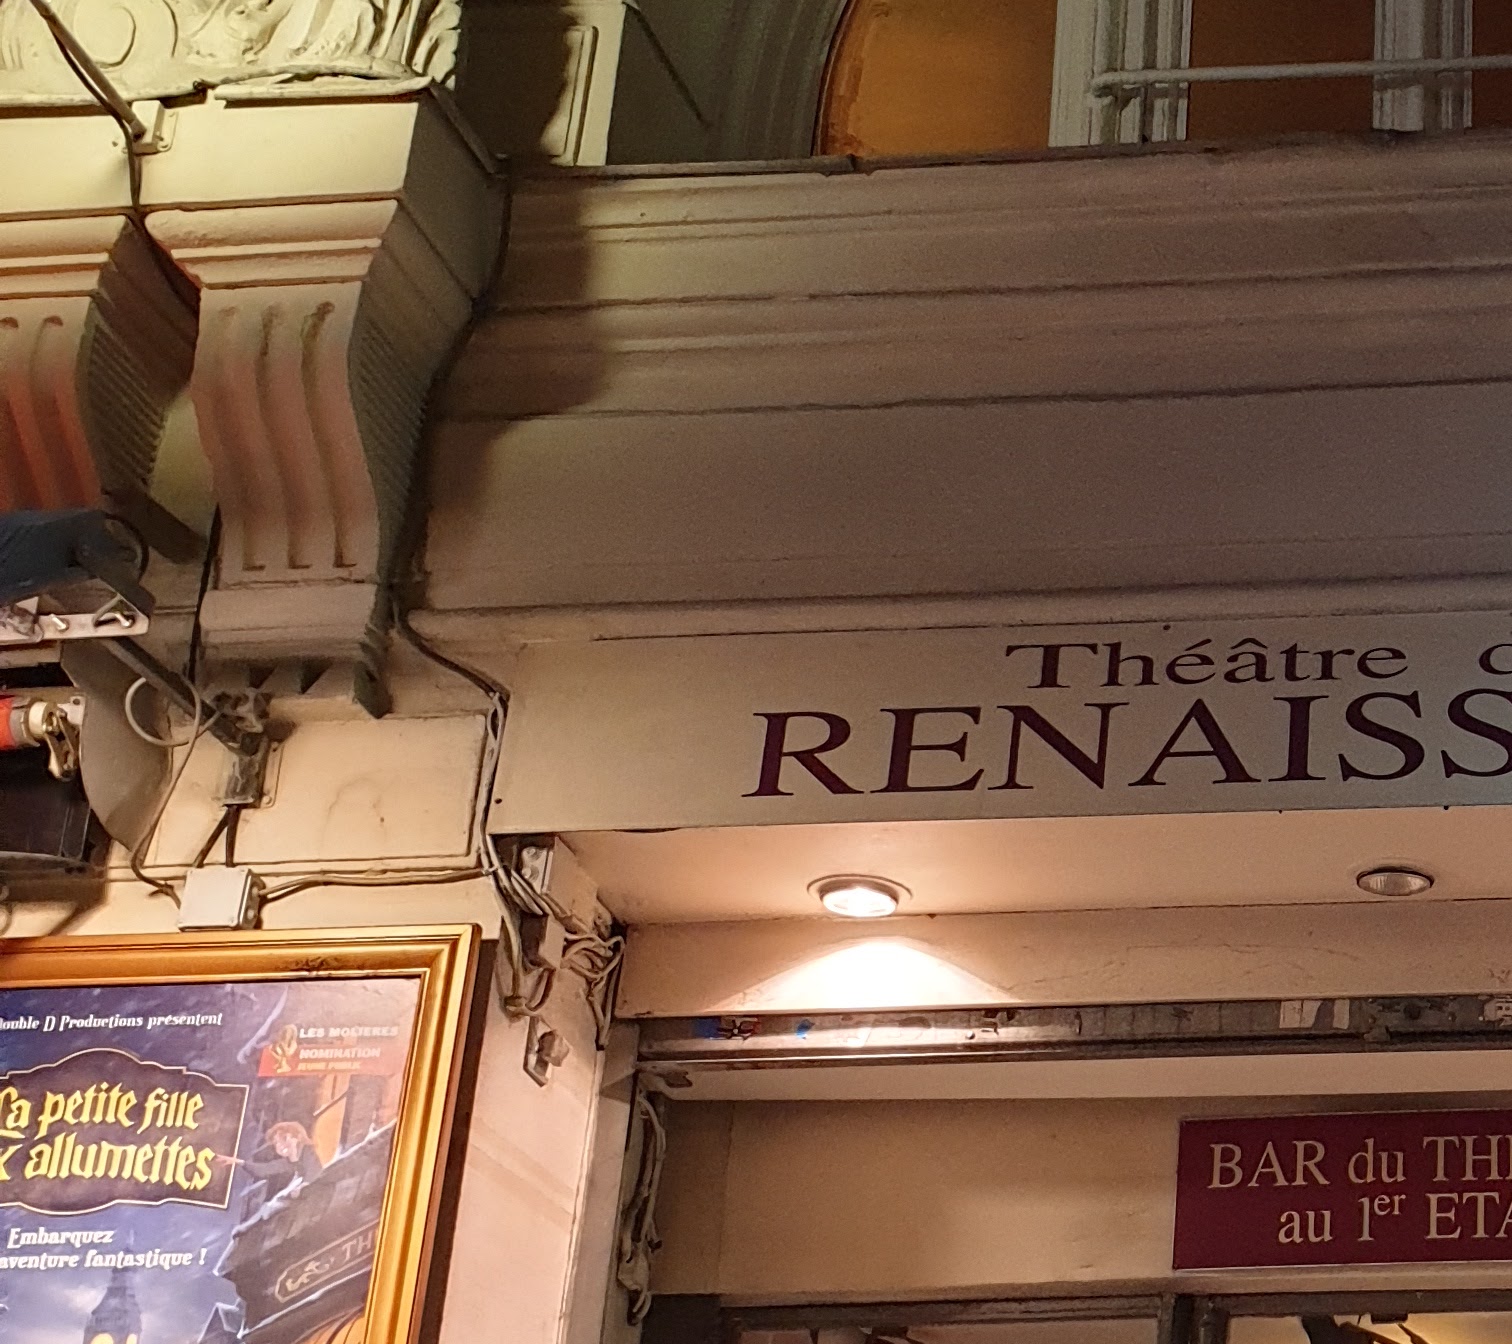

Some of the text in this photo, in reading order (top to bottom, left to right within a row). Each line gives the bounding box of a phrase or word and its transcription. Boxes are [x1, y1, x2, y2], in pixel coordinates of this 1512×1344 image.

[1004, 636, 1411, 690] Théâtre
[42, 1014, 57, 1032] D
[58, 1013, 145, 1033] Productions
[146, 1012, 224, 1030] présentent
[299, 1027, 326, 1039] LES
[36, 1081, 138, 1141] petite
[136, 1086, 205, 1136] fille
[23, 1131, 216, 1191] allumettes
[1206, 1139, 1331, 1191] BAR
[1347, 1137, 1407, 1185] du
[6, 1225, 117, 1249] Embarquez
[1277, 1208, 1334, 1245] au
[1356, 1191, 1408, 1243] 1er
[83, 1247, 194, 1271] fantastique
